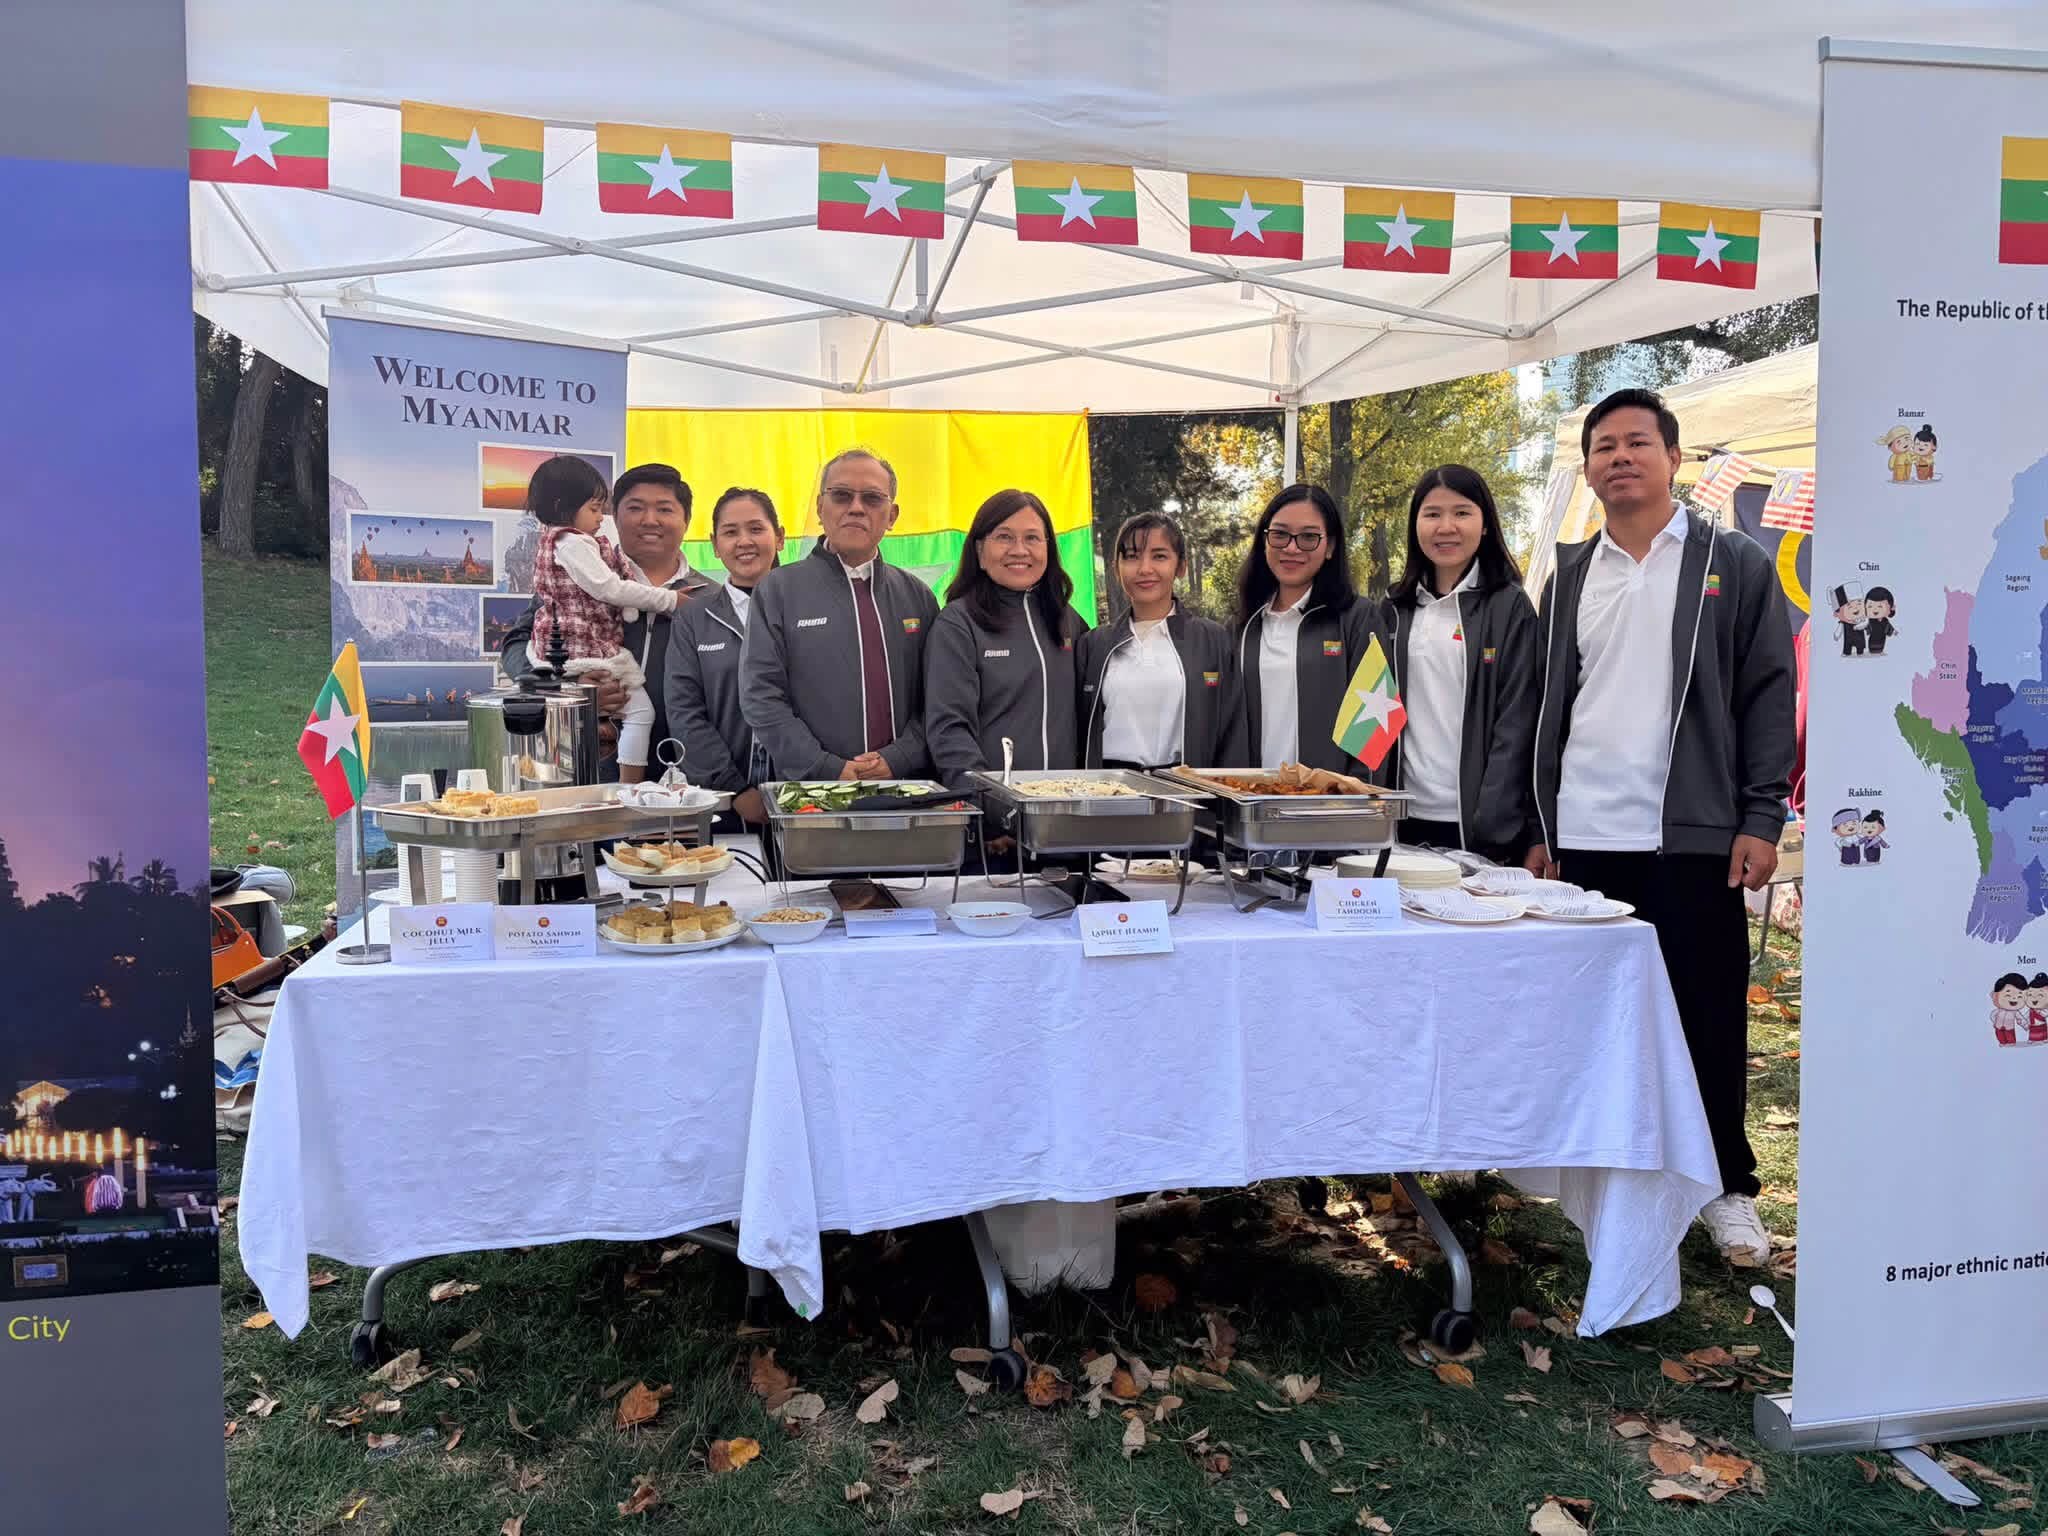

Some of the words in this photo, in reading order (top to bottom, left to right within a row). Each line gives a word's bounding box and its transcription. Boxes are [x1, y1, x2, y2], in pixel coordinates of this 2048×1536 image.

[1896, 298, 1930, 318] The
[1936, 299, 2010, 322] Republic
[2015, 302, 2035, 320] of
[2037, 300, 2048, 320] t
[372, 355, 547, 400] WELCOME
[556, 379, 598, 405] TO
[401, 395, 573, 437] MYANMAR
[1898, 407, 1926, 418] Bamar
[1858, 561, 1880, 571] Chin
[1848, 787, 1883, 798] Rakhine
[2017, 955, 2037, 965] Mon
[1886, 1265, 1897, 1282] 8
[1901, 1262, 1953, 1282] major
[1956, 1255, 2009, 1275] ethnic
[2013, 1251, 2048, 1271] nati
[7, 1315, 71, 1342] City
